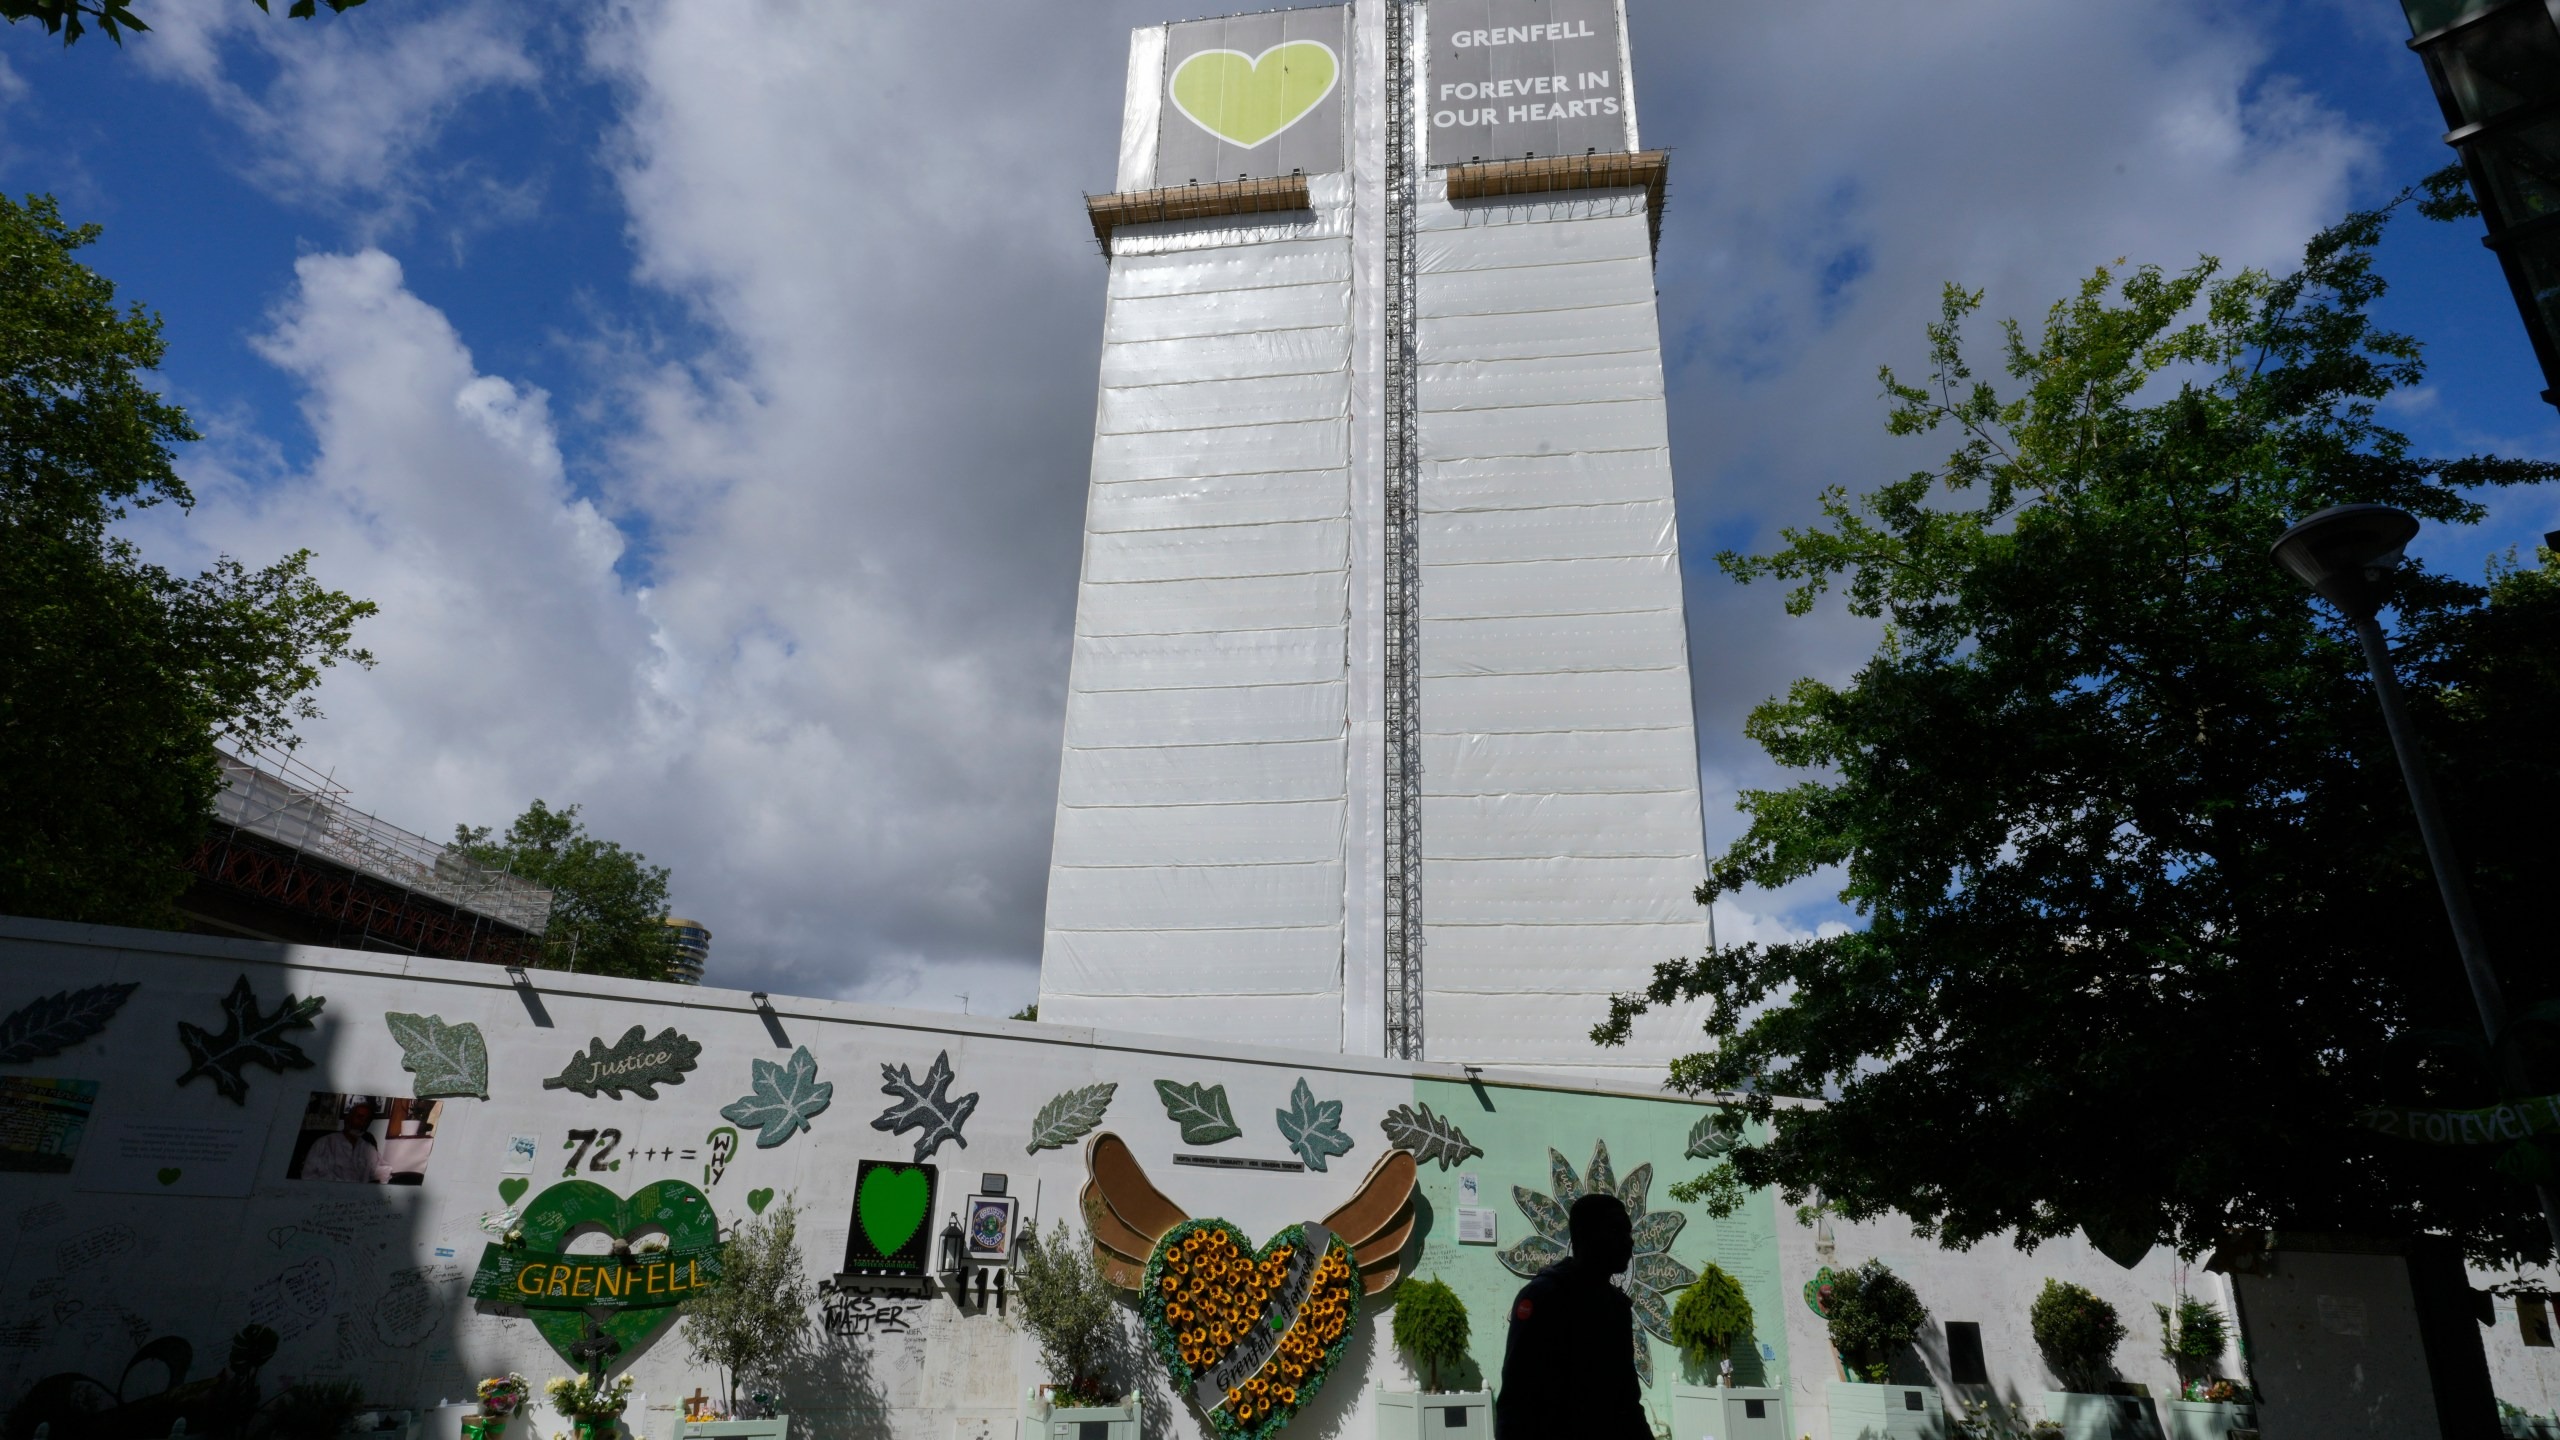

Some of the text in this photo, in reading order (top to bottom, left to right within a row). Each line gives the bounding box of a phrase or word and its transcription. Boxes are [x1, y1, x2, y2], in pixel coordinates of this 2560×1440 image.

[1451, 20, 1594, 49] GRENFELL
[1440, 70, 1610, 101] FOREVER IN
[1433, 96, 1619, 128] OUR HEARTS
[586, 1049, 673, 1083] Justice
[566, 1128, 622, 1173] 72
[1556, 1166, 1576, 1202] Futur
[977, 1232, 1003, 1246] LEGEND
[1641, 1222, 1667, 1242] Hope
[1514, 1250, 1558, 1264] Change
[1647, 1264, 1680, 1278] Unity
[517, 1259, 706, 1297] GRENFELL
[825, 1306, 911, 1334] MATTER
[1216, 1323, 1276, 1393] Grenfell
